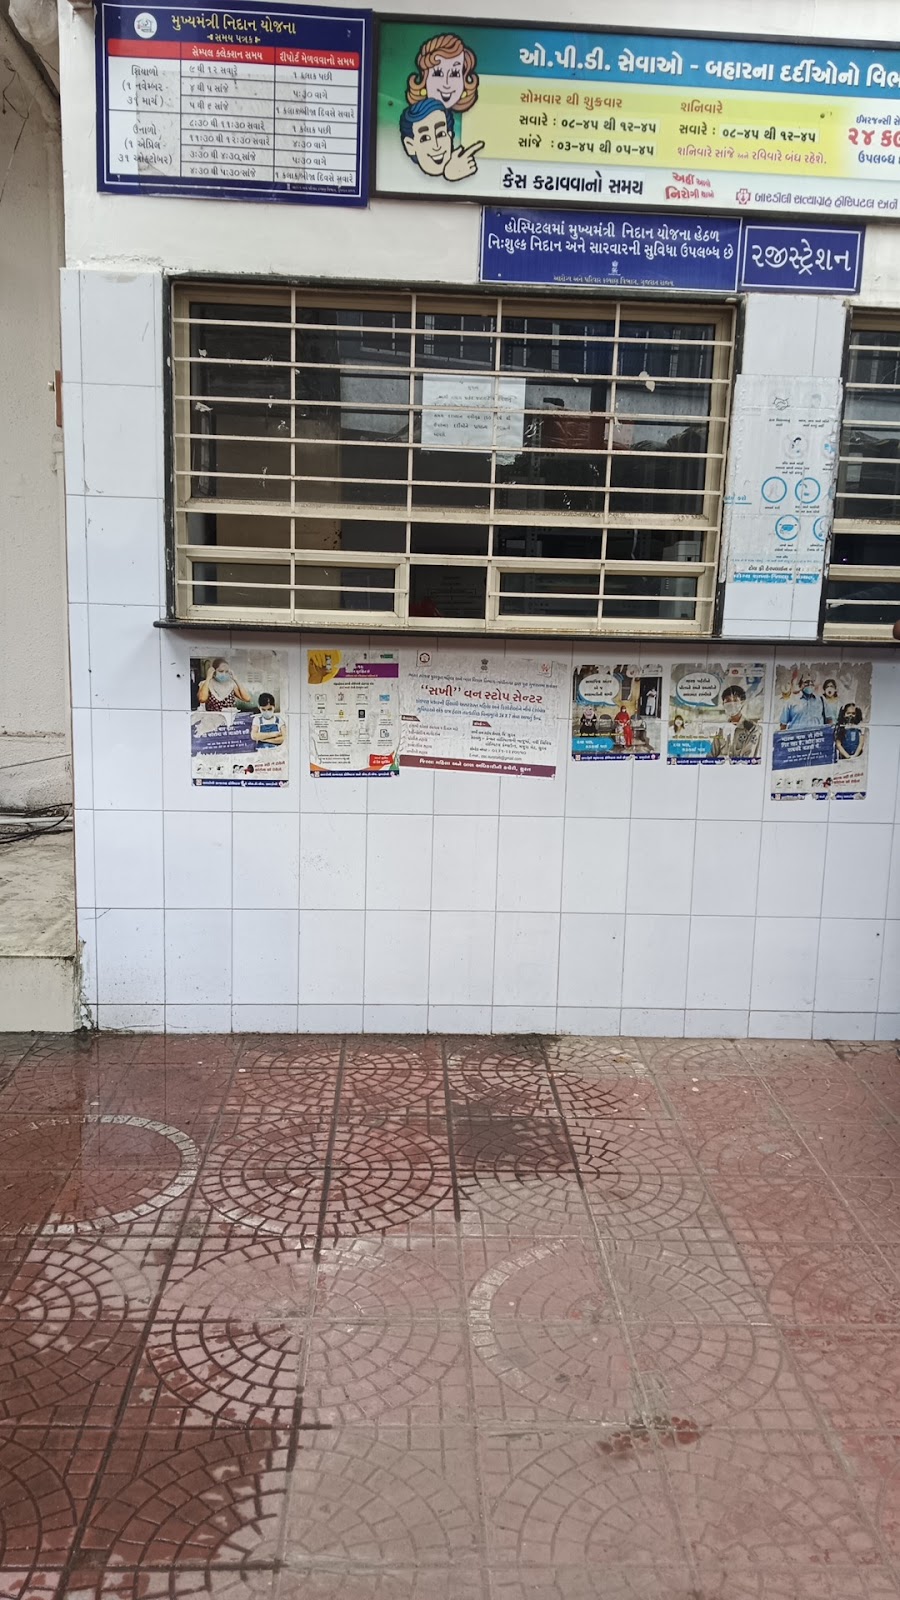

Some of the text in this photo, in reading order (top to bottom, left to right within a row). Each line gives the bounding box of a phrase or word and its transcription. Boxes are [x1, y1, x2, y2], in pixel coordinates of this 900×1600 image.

[172, 14, 296, 34] મુખ્યમંત્રી નિદાન યોજના
[214, 34, 234, 42] સમય
[192, 46, 214, 57] સેમ્પલ
[245, 51, 263, 60] સમય
[197, 63, 204, 73] થી
[337, 57, 355, 66] સમય
[519, 43, 611, 72] ઓ.પી.ડી.
[618, 48, 684, 76] સેવાઓ
[705, 60, 775, 81] બહારના
[780, 59, 860, 86] દર્દીઓનો
[131, 65, 158, 76] શિયાળો
[319, 71, 333, 80] પછી
[136, 80, 163, 92] નવેમ્બર
[197, 82, 204, 92] થી
[197, 100, 204, 109] થી
[520, 90, 562, 105] સોમવાર
[566, 93, 579, 106] થી
[680, 99, 723, 115] શનિવારે
[211, 118, 218, 127] થી
[519, 112, 548, 127] સવારે
[603, 117, 616, 131] થી
[133, 124, 156, 135] ઉનાળો
[318, 125, 331, 134] પછી
[679, 122, 708, 136] સવારે
[764, 126, 776, 140] થી
[216, 133, 223, 143] થી
[518, 133, 542, 149] સાંજે
[600, 140, 611, 154] થી
[848, 127, 874, 147] ૨૪
[211, 149, 218, 159] થી
[677, 144, 712, 158] શનિવારે
[715, 146, 734, 159] સાંજે
[752, 148, 782, 161] રવિવારે
[785, 150, 801, 163] બંધ
[804, 152, 827, 164] રહેશે.
[858, 150, 895, 165] ઉપલબ્ધ
[211, 166, 218, 175] થી
[502, 167, 643, 195] કેસ કઢાવવાનો સમય
[672, 172, 694, 185] અહીં
[665, 186, 699, 200] નિરોગી
[505, 217, 720, 242] હોસ્પિટલમાં મુખ્યમંત્રી નિદાન યોજના હેઠળ
[530, 235, 562, 252] નિદાન
[565, 237, 586, 253] અને
[590, 240, 641, 256] સારવારની
[644, 241, 677, 260] સુવિધા
[681, 242, 720, 259] ઉપલબ્ધ
[723, 244, 733, 259] છે
[752, 239, 851, 275] રજીસ્ટ્રેશન
[464, 689, 482, 699] વન
[484, 689, 510, 701] સ્ટોપ
[513, 690, 543, 704] સેન્ટર
